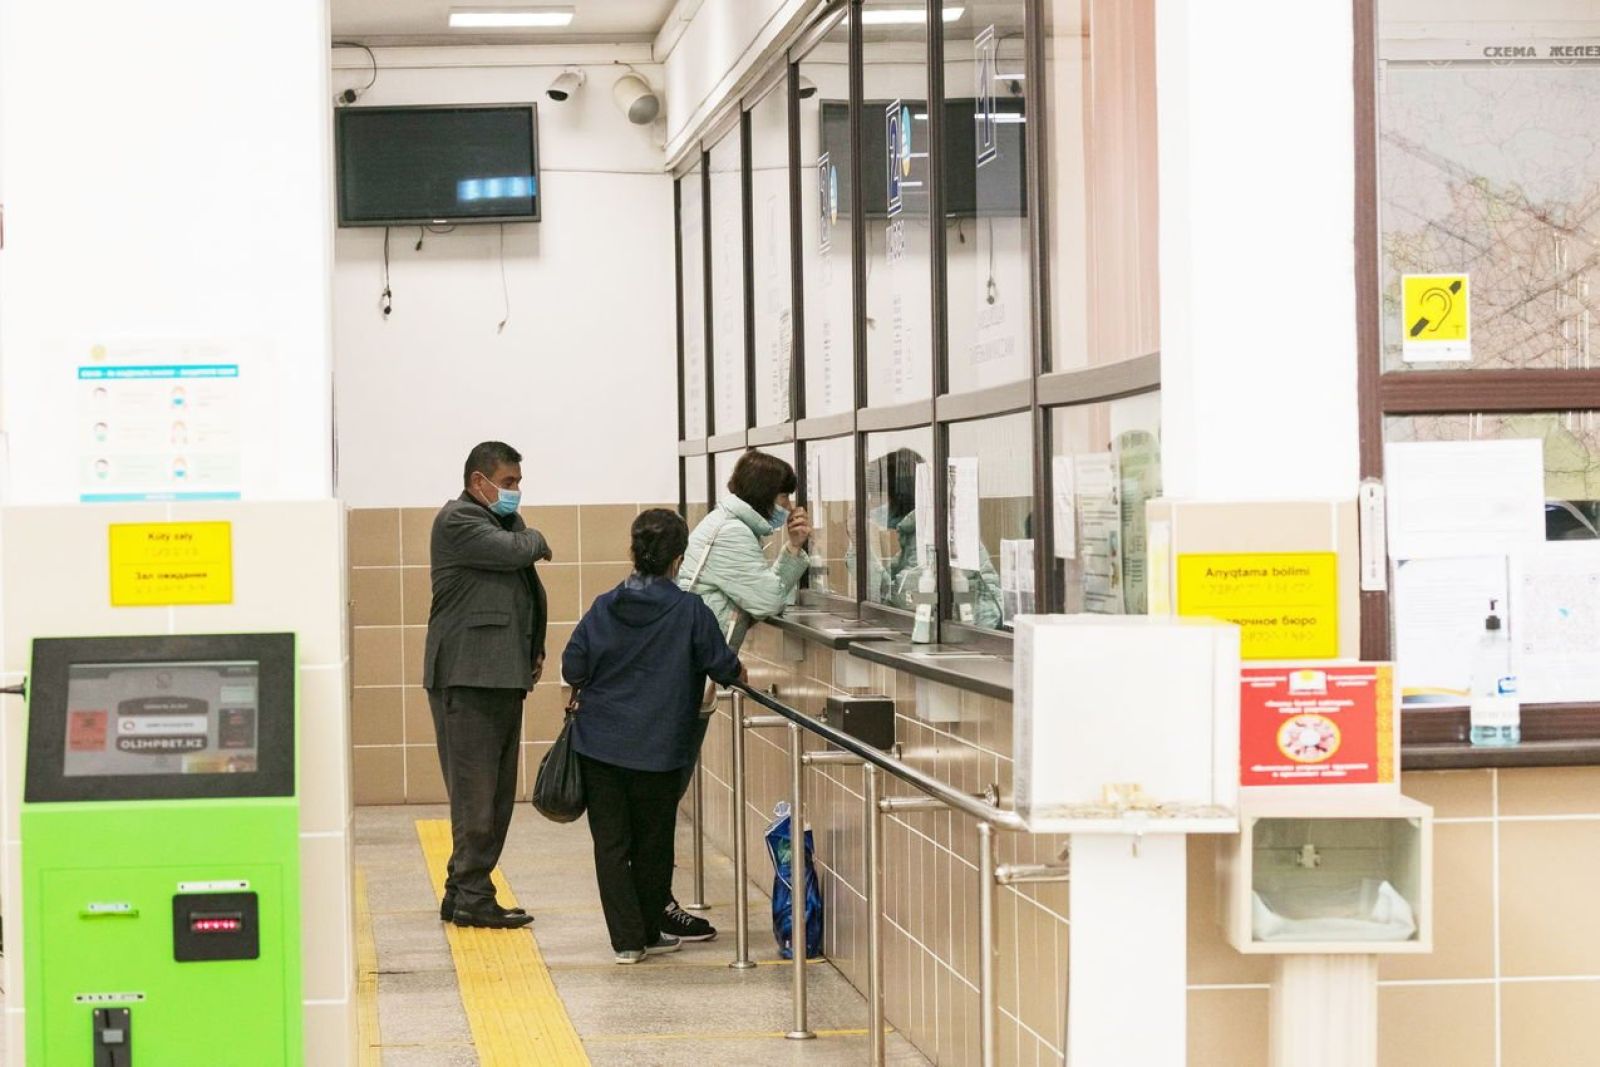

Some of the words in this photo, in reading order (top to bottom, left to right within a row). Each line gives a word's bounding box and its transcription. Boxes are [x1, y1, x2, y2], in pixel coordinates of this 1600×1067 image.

[1483, 46, 1536, 57] СХЕМА
[1205, 567, 1268, 580] Anyqtama
[1282, 615, 1317, 628] бюро
[120, 737, 204, 751] OLIMPBET.KZ
